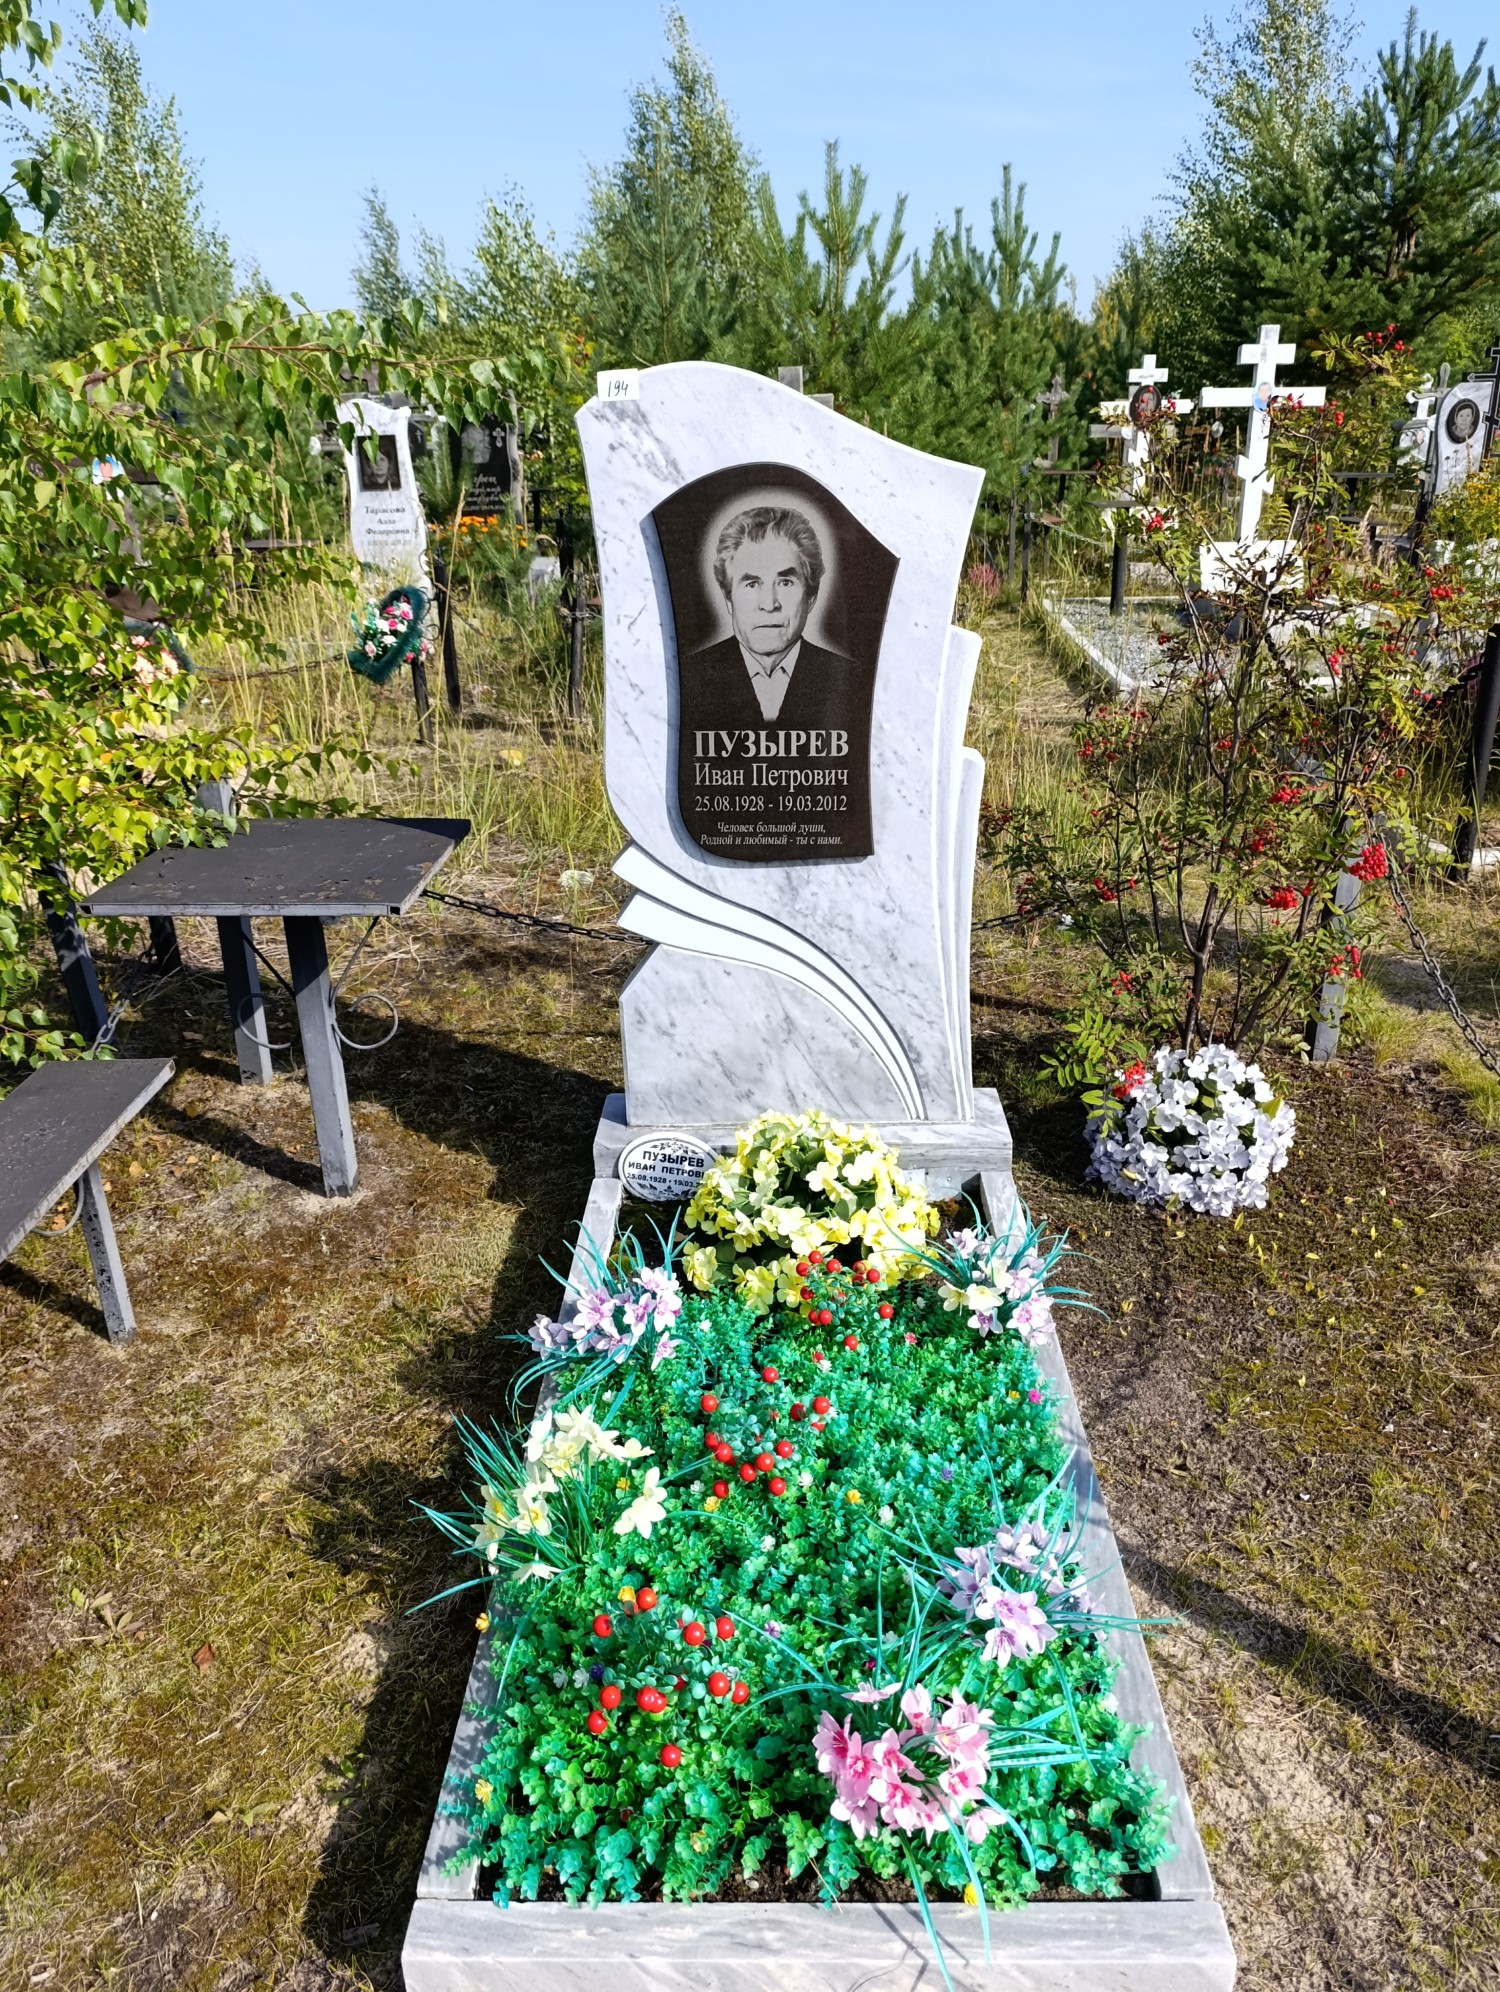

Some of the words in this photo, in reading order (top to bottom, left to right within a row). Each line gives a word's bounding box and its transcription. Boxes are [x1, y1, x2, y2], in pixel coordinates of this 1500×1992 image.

[607, 380, 629, 397] 194
[364, 506, 406, 515] Тарасова
[693, 729, 849, 758] ПУЗЫРЕВ
[694, 762, 745, 786] Иван
[751, 763, 849, 793] Петрович
[695, 795, 765, 812] 25.08.1928
[778, 795, 848, 812] 19.03.2012
[717, 821, 755, 833] Человек
[756, 821, 797, 833] большой
[798, 824, 826, 835] души,
[700, 834, 733, 846] Родной
[735, 836, 742, 845] и
[743, 834, 788, 845] любимый
[796, 836, 808, 845] ты
[809, 836, 816, 845] с
[817, 836, 843, 845] нами.
[628, 1161, 656, 1172] ИВАН
[642, 1150, 705, 1168] ПУЗЫРЕВ
[626, 1172, 667, 1184] 25.08.1928
